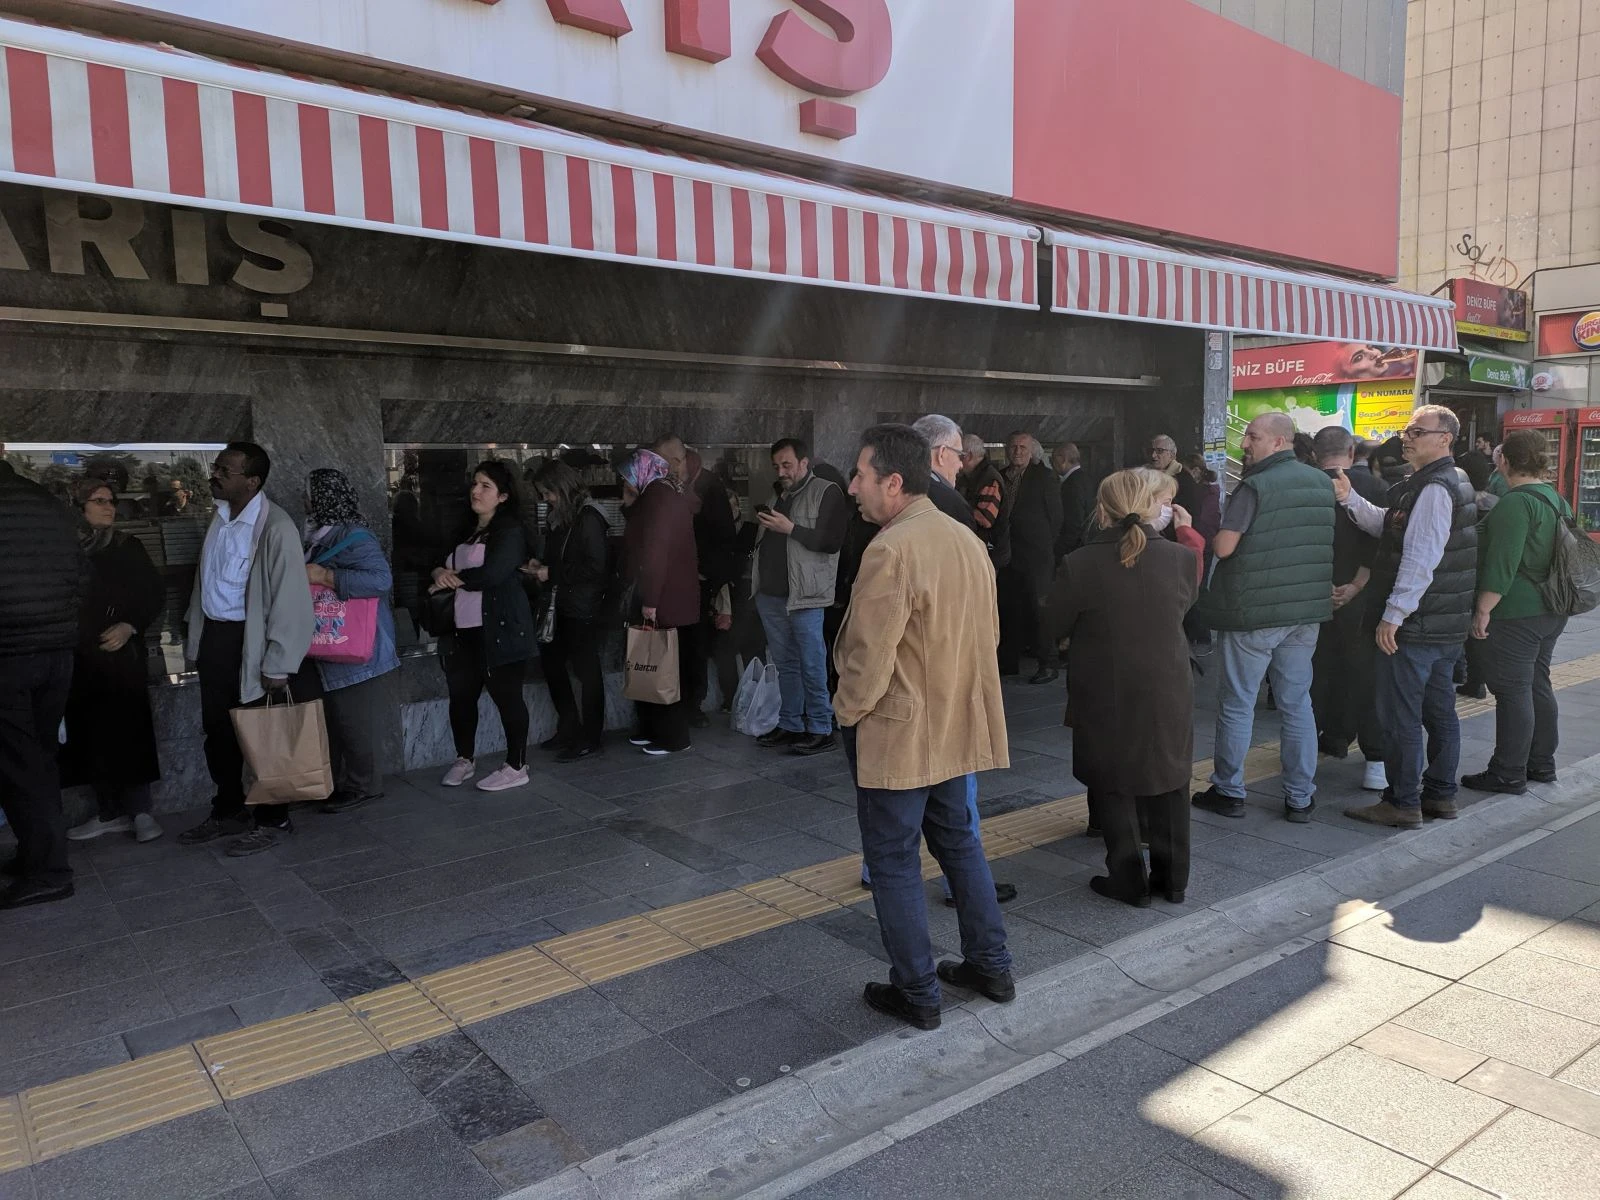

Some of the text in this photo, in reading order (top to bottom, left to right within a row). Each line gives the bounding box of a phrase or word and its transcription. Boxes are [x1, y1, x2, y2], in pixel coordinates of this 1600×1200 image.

[1483, 296, 1497, 311] BÜFE
[1577, 318, 1600, 333] BURG
[1265, 358, 1305, 374] BÜFE
[1487, 367, 1499, 380] Deniz
[1376, 389, 1414, 397] NUMARA
